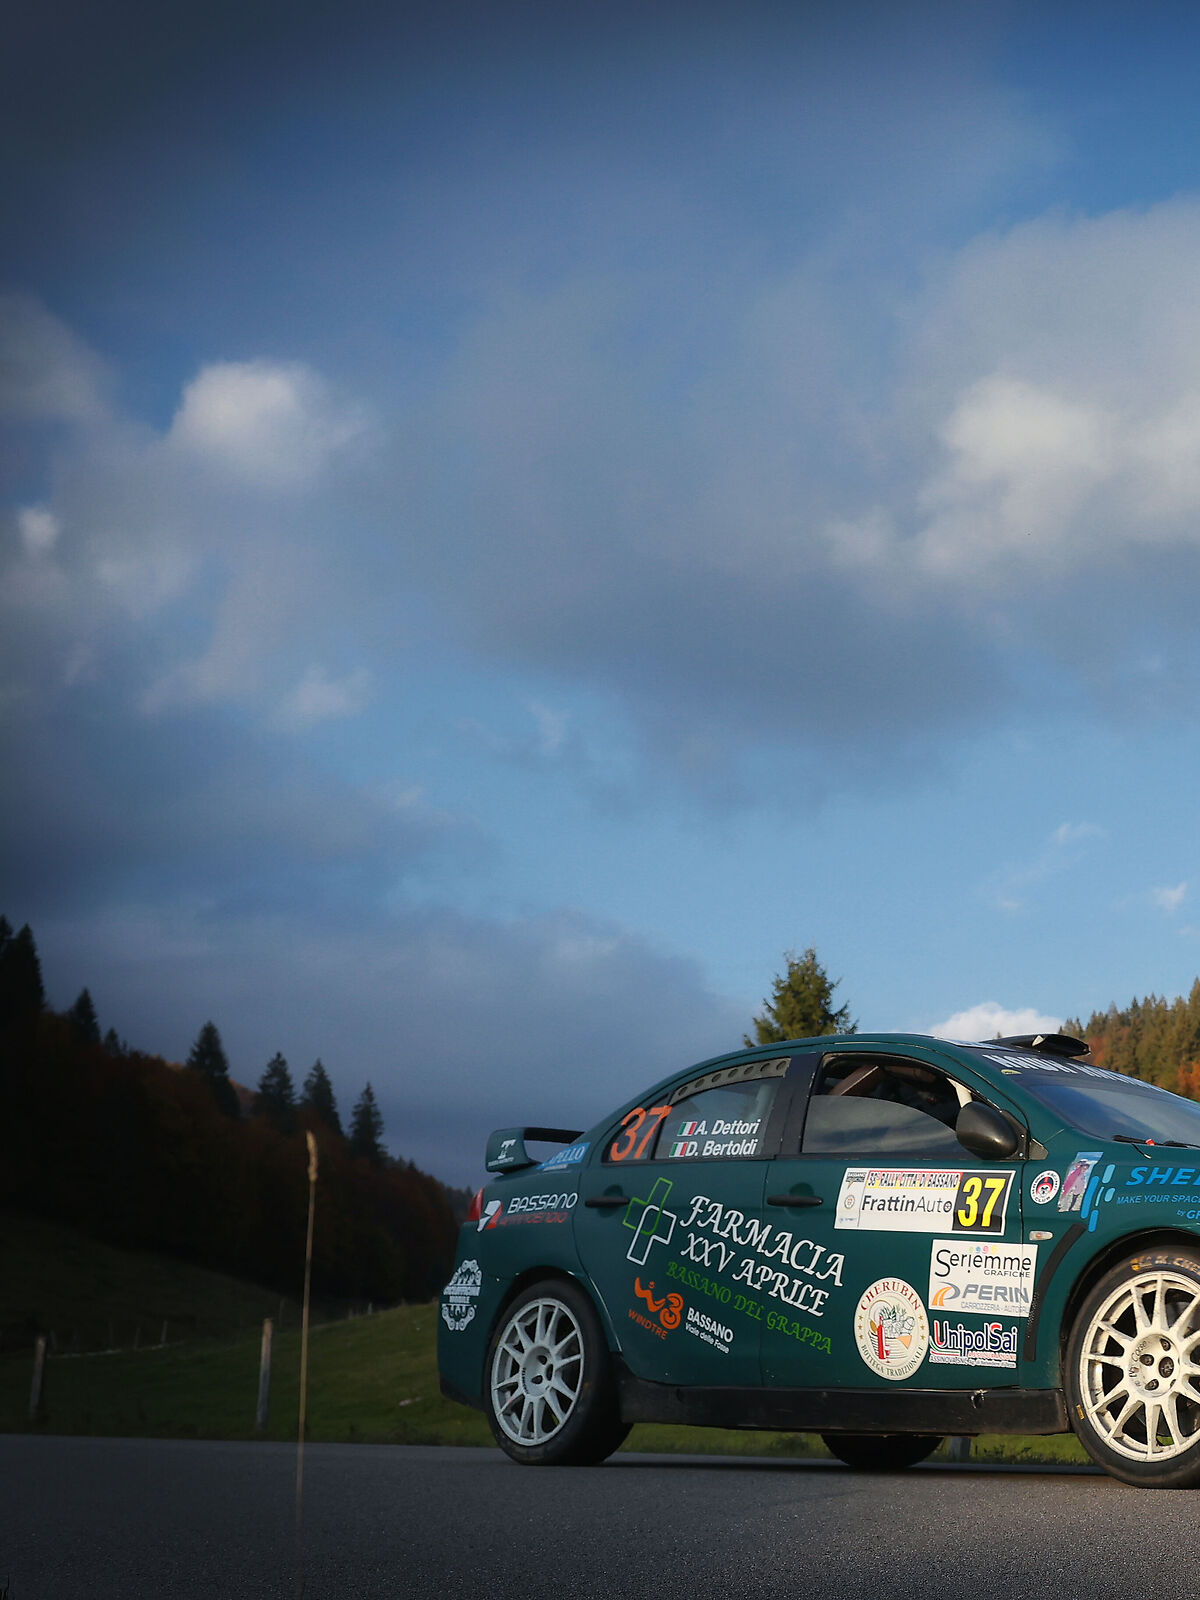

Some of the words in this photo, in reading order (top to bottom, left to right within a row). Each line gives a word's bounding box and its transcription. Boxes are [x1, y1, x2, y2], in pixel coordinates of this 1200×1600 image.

[610, 1105, 673, 1161] 37
[694, 1120, 707, 1136] A.
[711, 1119, 761, 1136] Dettori
[685, 1141, 698, 1157] D.
[702, 1139, 758, 1157] Bertoldi
[927, 1173, 960, 1188] BASSANO
[507, 1192, 578, 1214] BASSANO
[861, 1195, 953, 1213] FrattinAuto
[957, 1176, 1006, 1227] 37
[1117, 1196, 1141, 1205] MAKE
[1144, 1194, 1170, 1204] YOUR
[679, 1195, 846, 1287] FARMACIA
[680, 1233, 736, 1273] XXV
[732, 1258, 830, 1317] APRILE
[934, 1248, 1032, 1278] Seriemme
[983, 1269, 1031, 1278] GRAFICHE
[666, 1261, 732, 1304] BASSANO
[733, 1294, 763, 1322] DEL
[766, 1311, 833, 1355] GRAPPA
[860, 1281, 921, 1311] CHERUBIN
[962, 1283, 1030, 1304] PERIN
[628, 1308, 669, 1341] WINDTRE
[686, 1306, 734, 1343] BASSANO
[934, 1319, 1017, 1358] UnipolSai
[860, 1344, 884, 1374] BOTTEGA
